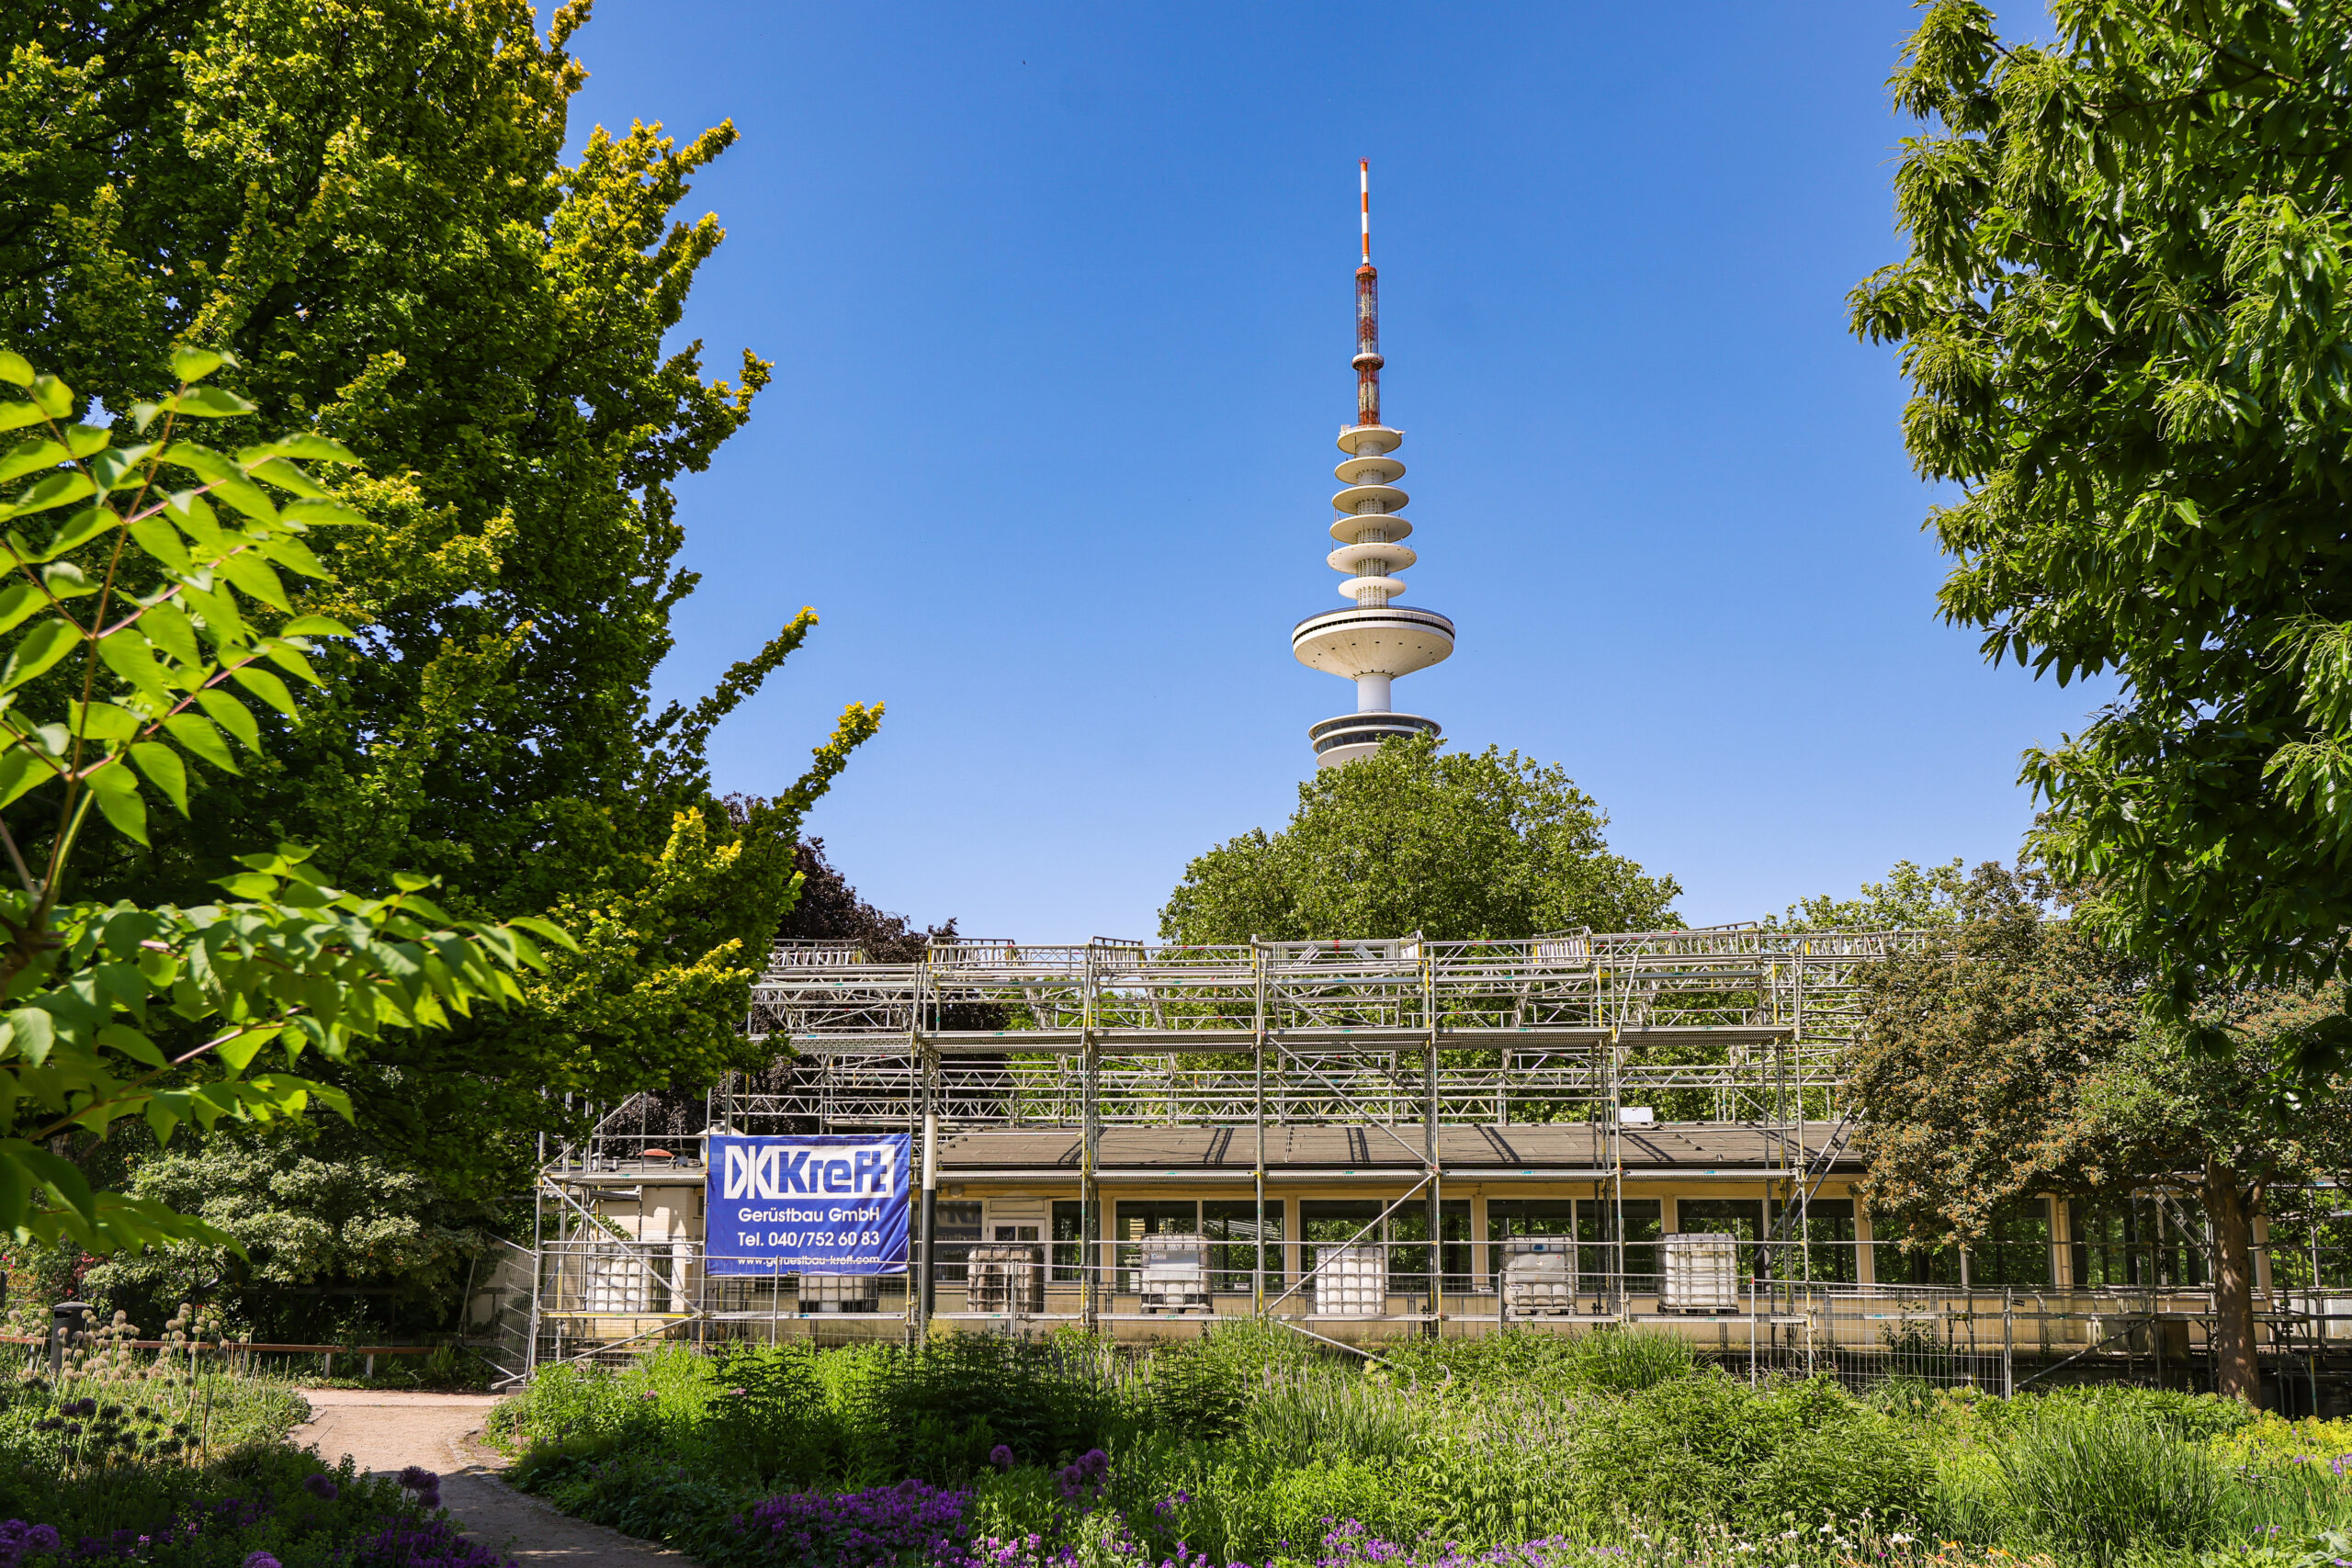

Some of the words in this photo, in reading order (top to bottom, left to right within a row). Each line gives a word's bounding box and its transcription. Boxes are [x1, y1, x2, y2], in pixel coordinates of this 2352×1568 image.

[778, 1150, 888, 1193] Kreft
[738, 1207, 823, 1223] Gerüstbau
[829, 1206, 880, 1222] GmbH
[738, 1232, 764, 1247] Tel.
[768, 1231, 834, 1247] 040/752
[839, 1231, 857, 1247] 60
[861, 1230, 880, 1246] 83
